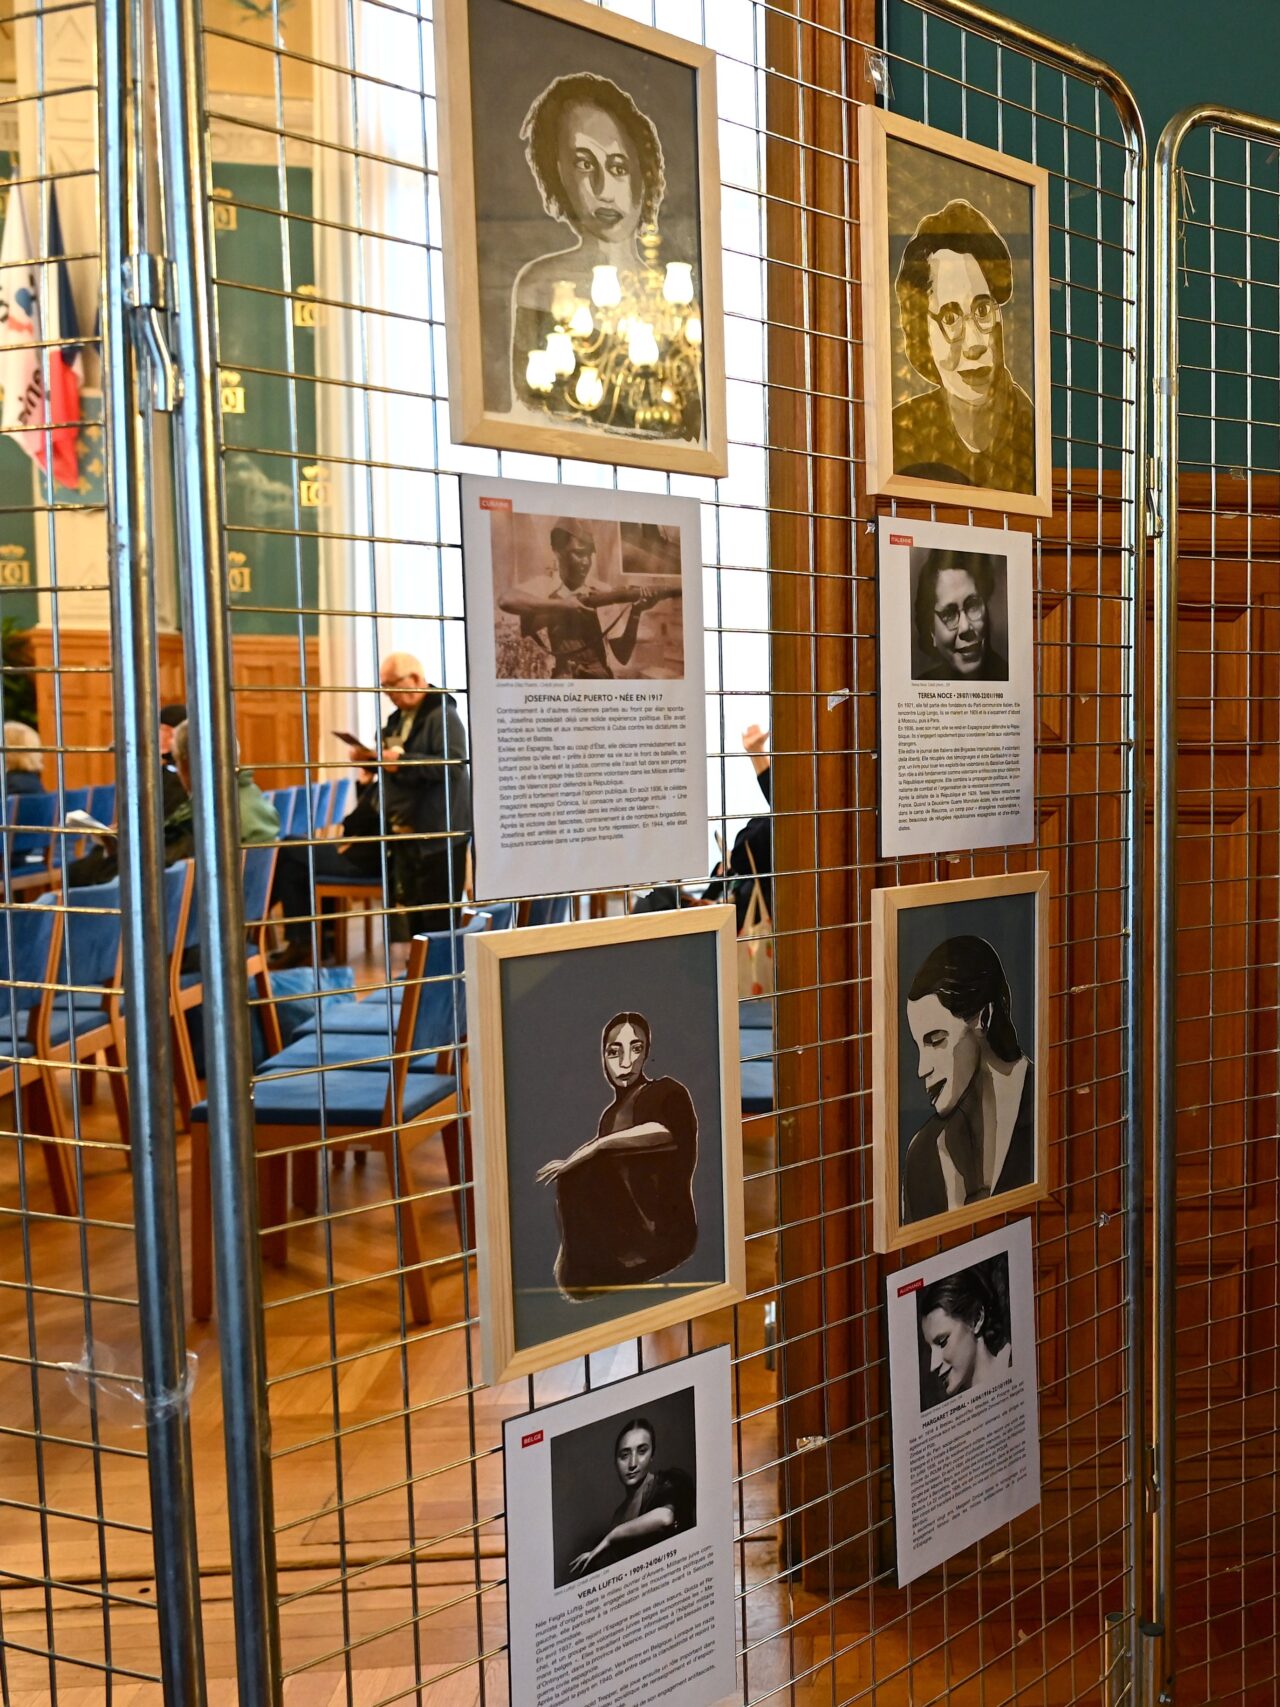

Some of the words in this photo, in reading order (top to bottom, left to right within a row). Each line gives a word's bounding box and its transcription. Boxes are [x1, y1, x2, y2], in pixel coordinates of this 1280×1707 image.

[524, 695, 561, 704] JOSEFINA
[563, 694, 582, 702] DÍAZ
[619, 694, 633, 702] NÉE
[922, 1411, 949, 1429] MARGARET
[524, 1433, 541, 1444] BELGE
[578, 1586, 596, 1600] VERA
[598, 1574, 623, 1591] LUFTIG
[629, 1550, 676, 1577] 1909-24/06/1959
